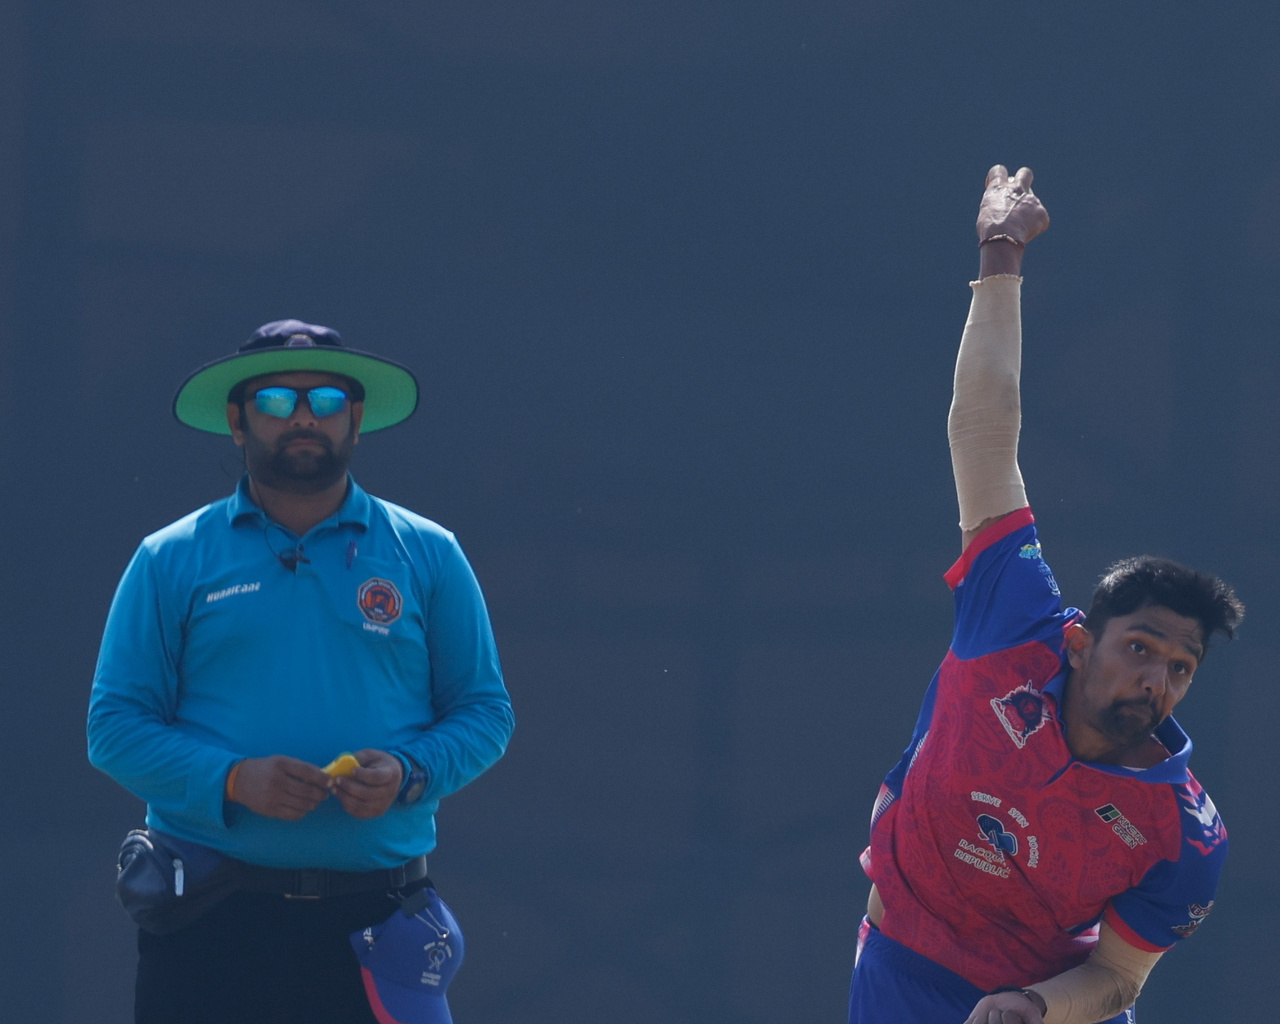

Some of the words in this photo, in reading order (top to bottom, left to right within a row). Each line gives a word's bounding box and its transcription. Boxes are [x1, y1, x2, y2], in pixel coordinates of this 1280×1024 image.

[970, 791, 1001, 807] SERVE
[1008, 807, 1029, 828] SPIN
[1027, 835, 1039, 868] SOCIAL
[1112, 823, 1138, 849] GREEN
[1117, 815, 1147, 845] KINETIC
[954, 848, 1011, 878] REPUBLIC
